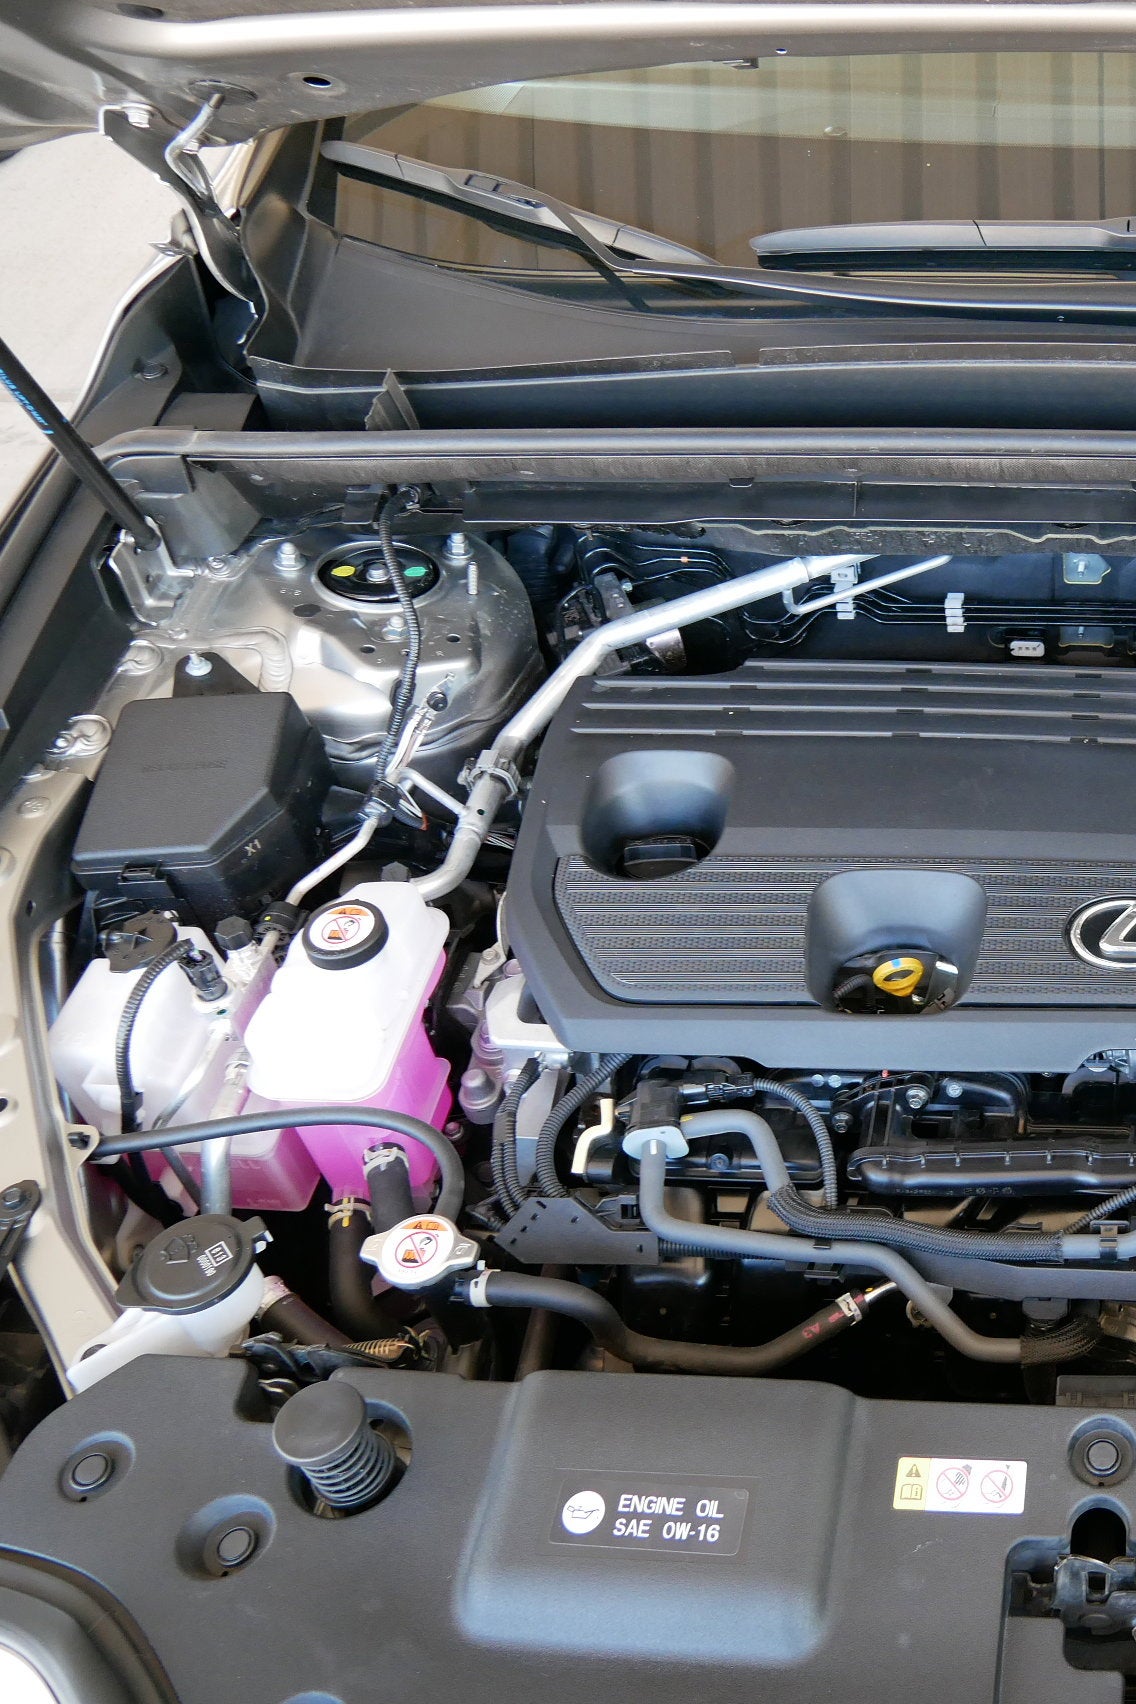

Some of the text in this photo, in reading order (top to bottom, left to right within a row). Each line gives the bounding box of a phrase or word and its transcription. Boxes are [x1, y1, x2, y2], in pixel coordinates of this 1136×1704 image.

[617, 1494, 724, 1518] ENGINE OIL
[613, 1518, 720, 1542] SAE 0W-16
